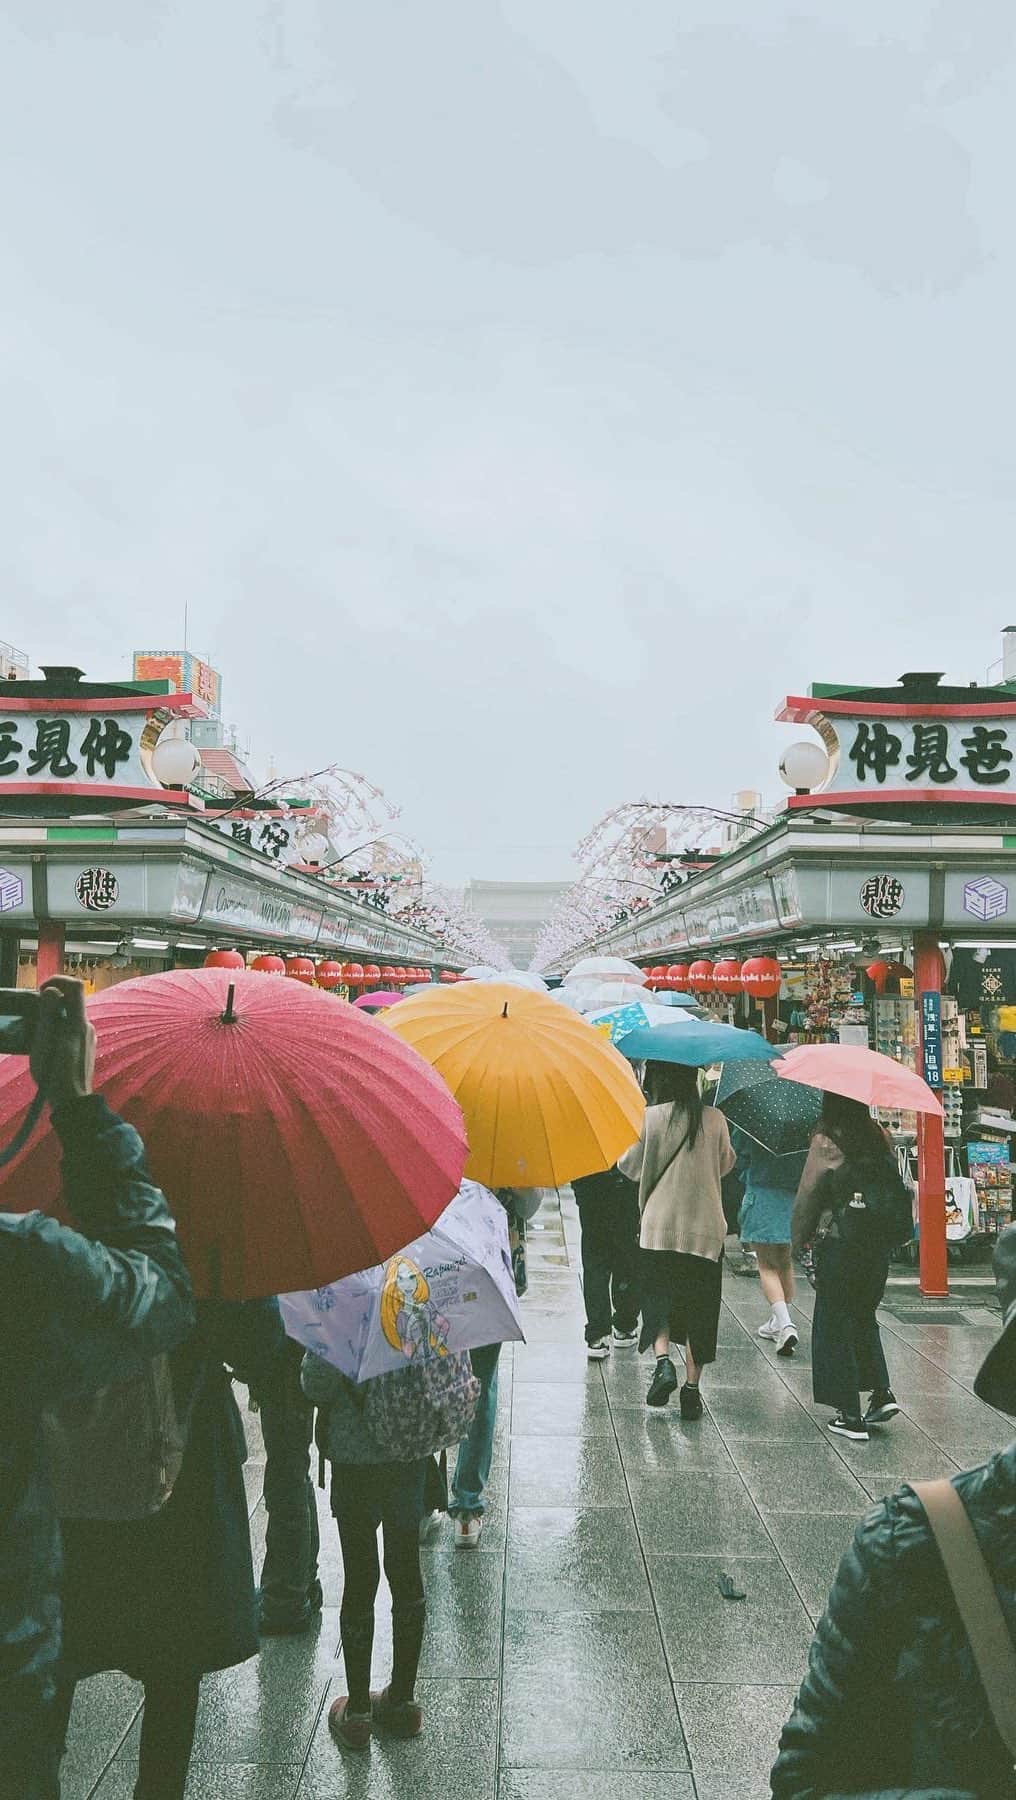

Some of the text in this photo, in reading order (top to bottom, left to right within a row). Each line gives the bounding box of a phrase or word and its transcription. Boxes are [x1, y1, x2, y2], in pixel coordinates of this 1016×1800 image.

[849, 722, 1013, 784] 仲見世
[927, 1071, 939, 1082] 18
